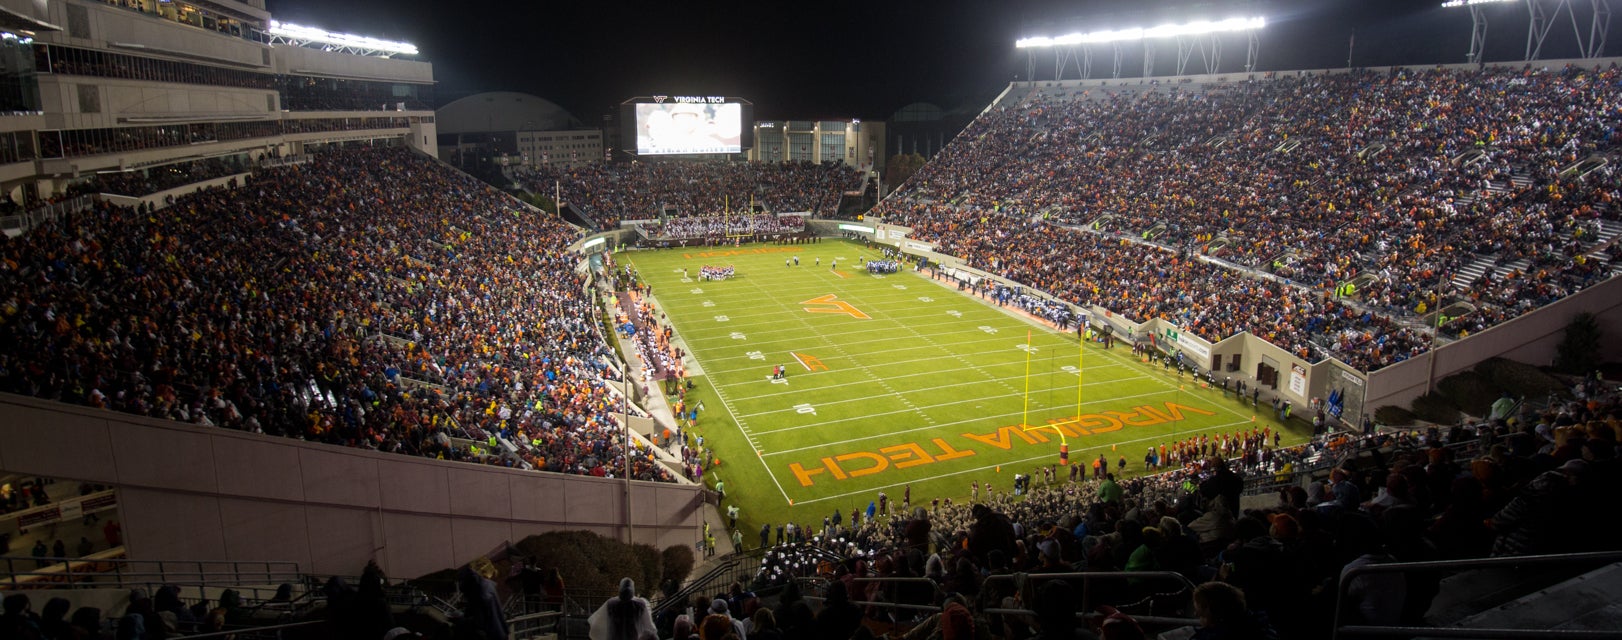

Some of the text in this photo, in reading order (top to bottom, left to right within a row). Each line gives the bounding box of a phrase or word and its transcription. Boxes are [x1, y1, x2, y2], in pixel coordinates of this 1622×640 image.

[792, 403, 815, 414] 10
[789, 401, 1217, 487] VIRGINIA TECH
